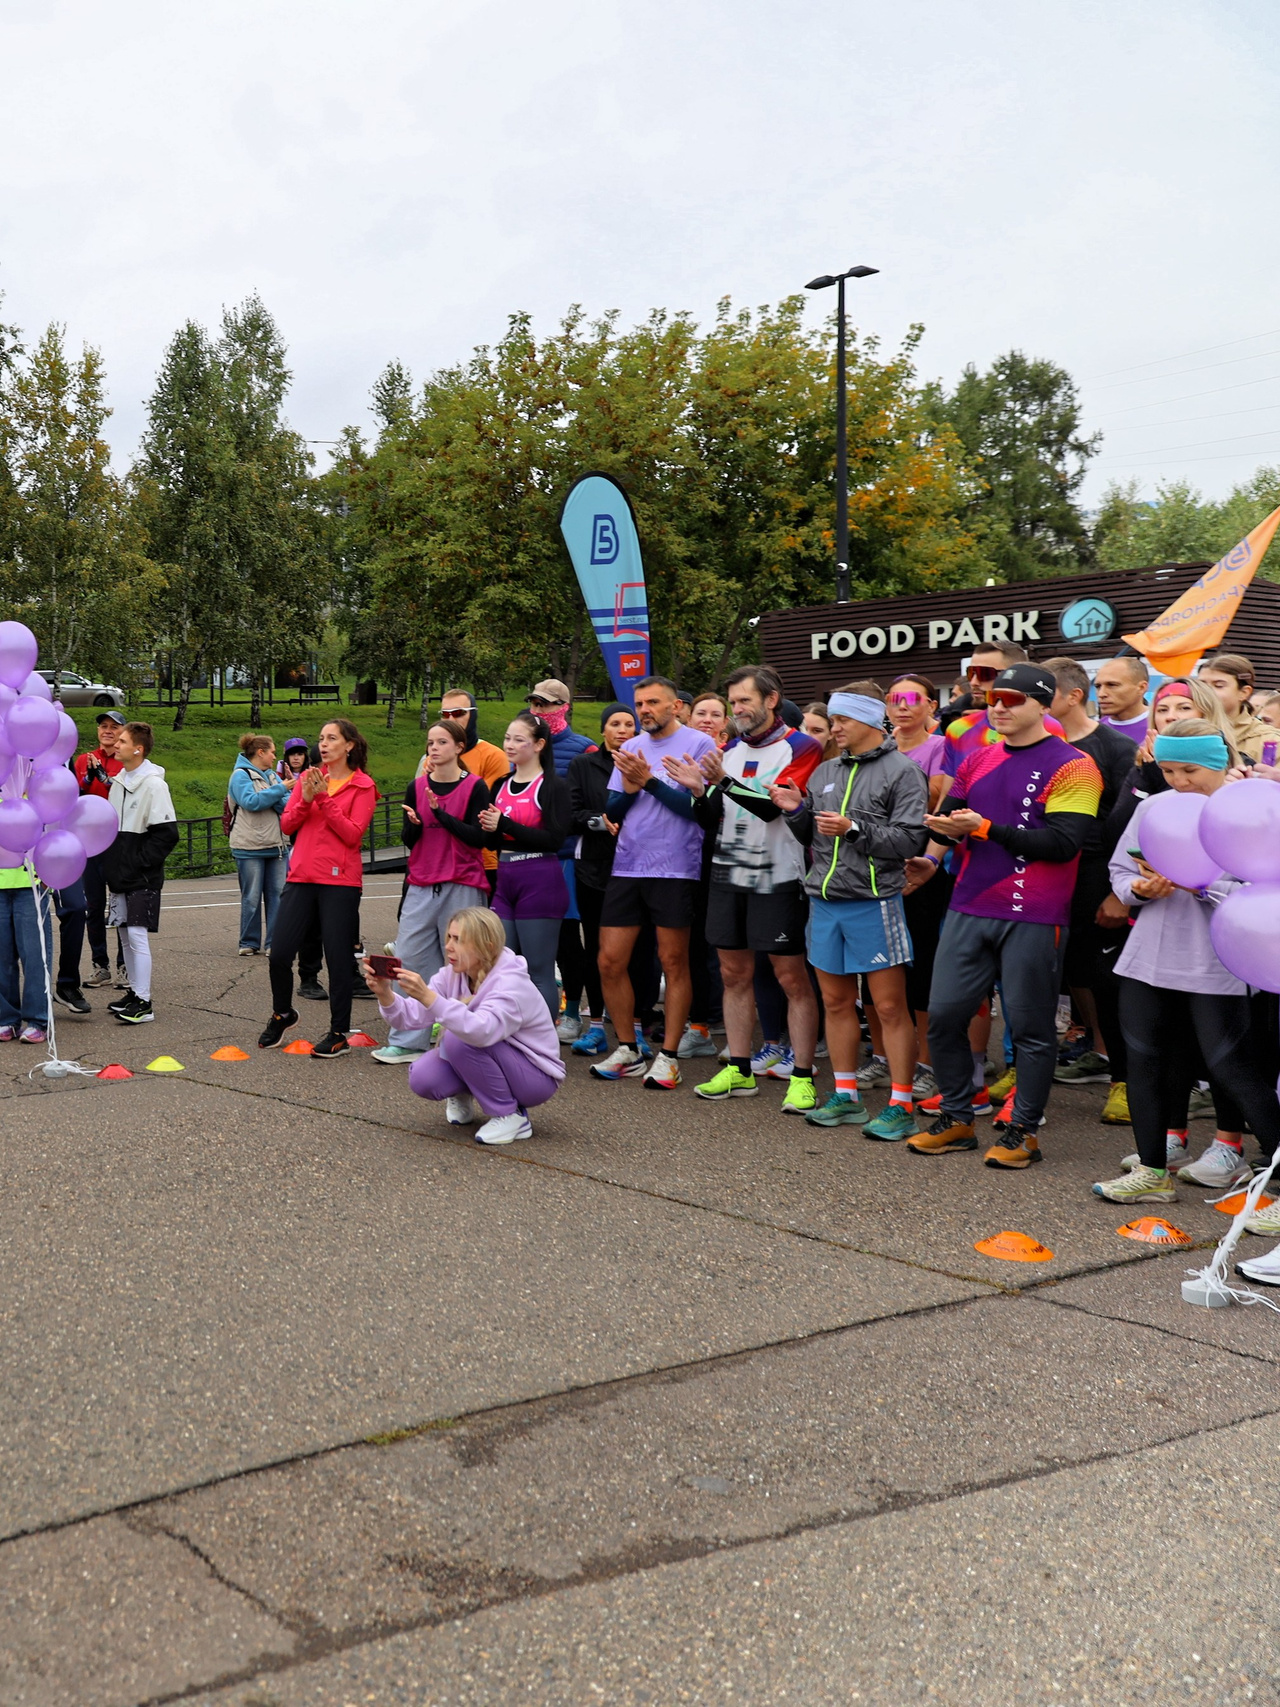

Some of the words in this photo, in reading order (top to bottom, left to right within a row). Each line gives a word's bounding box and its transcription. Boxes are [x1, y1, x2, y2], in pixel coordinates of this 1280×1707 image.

[811, 624, 916, 660] FOOD
[928, 610, 1041, 649] PARK
[509, 854, 526, 862] NIKE
